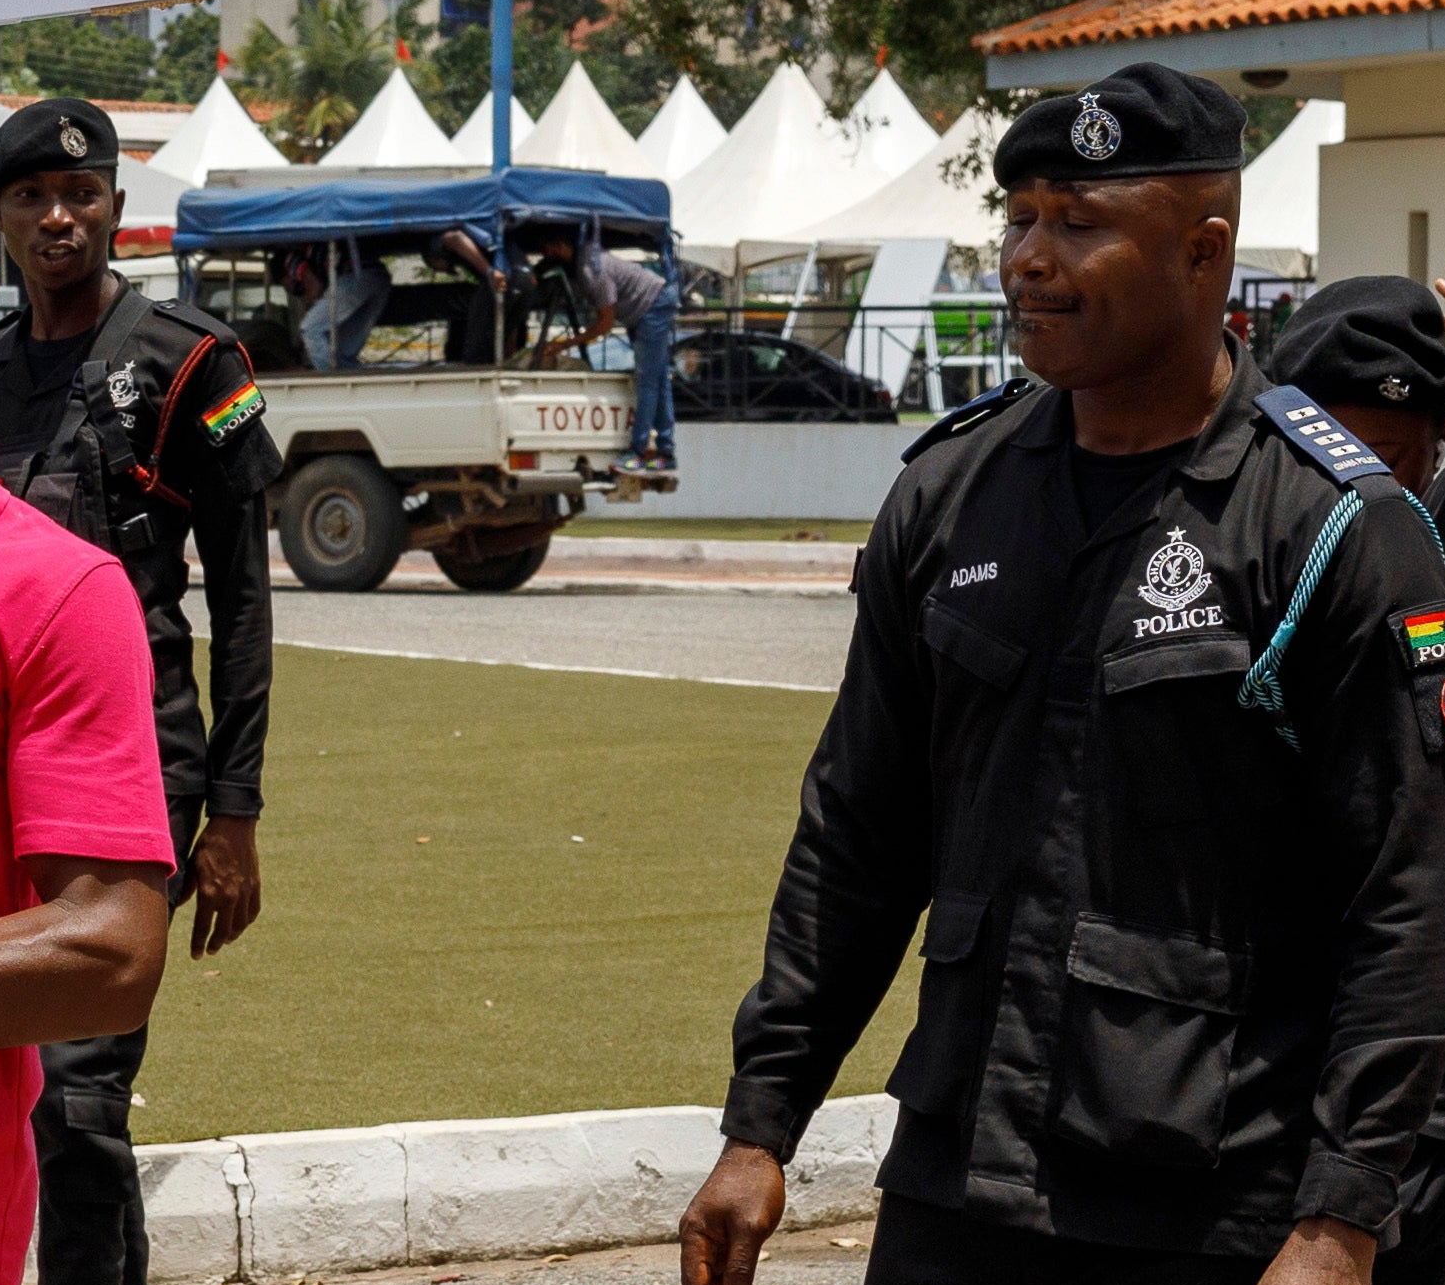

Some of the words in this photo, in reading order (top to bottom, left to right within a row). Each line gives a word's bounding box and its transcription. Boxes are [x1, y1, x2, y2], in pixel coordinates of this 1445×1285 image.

[217, 398, 264, 437] POLICE
[950, 562, 999, 589] ADAMS
[1133, 606, 1224, 638] POLICE
